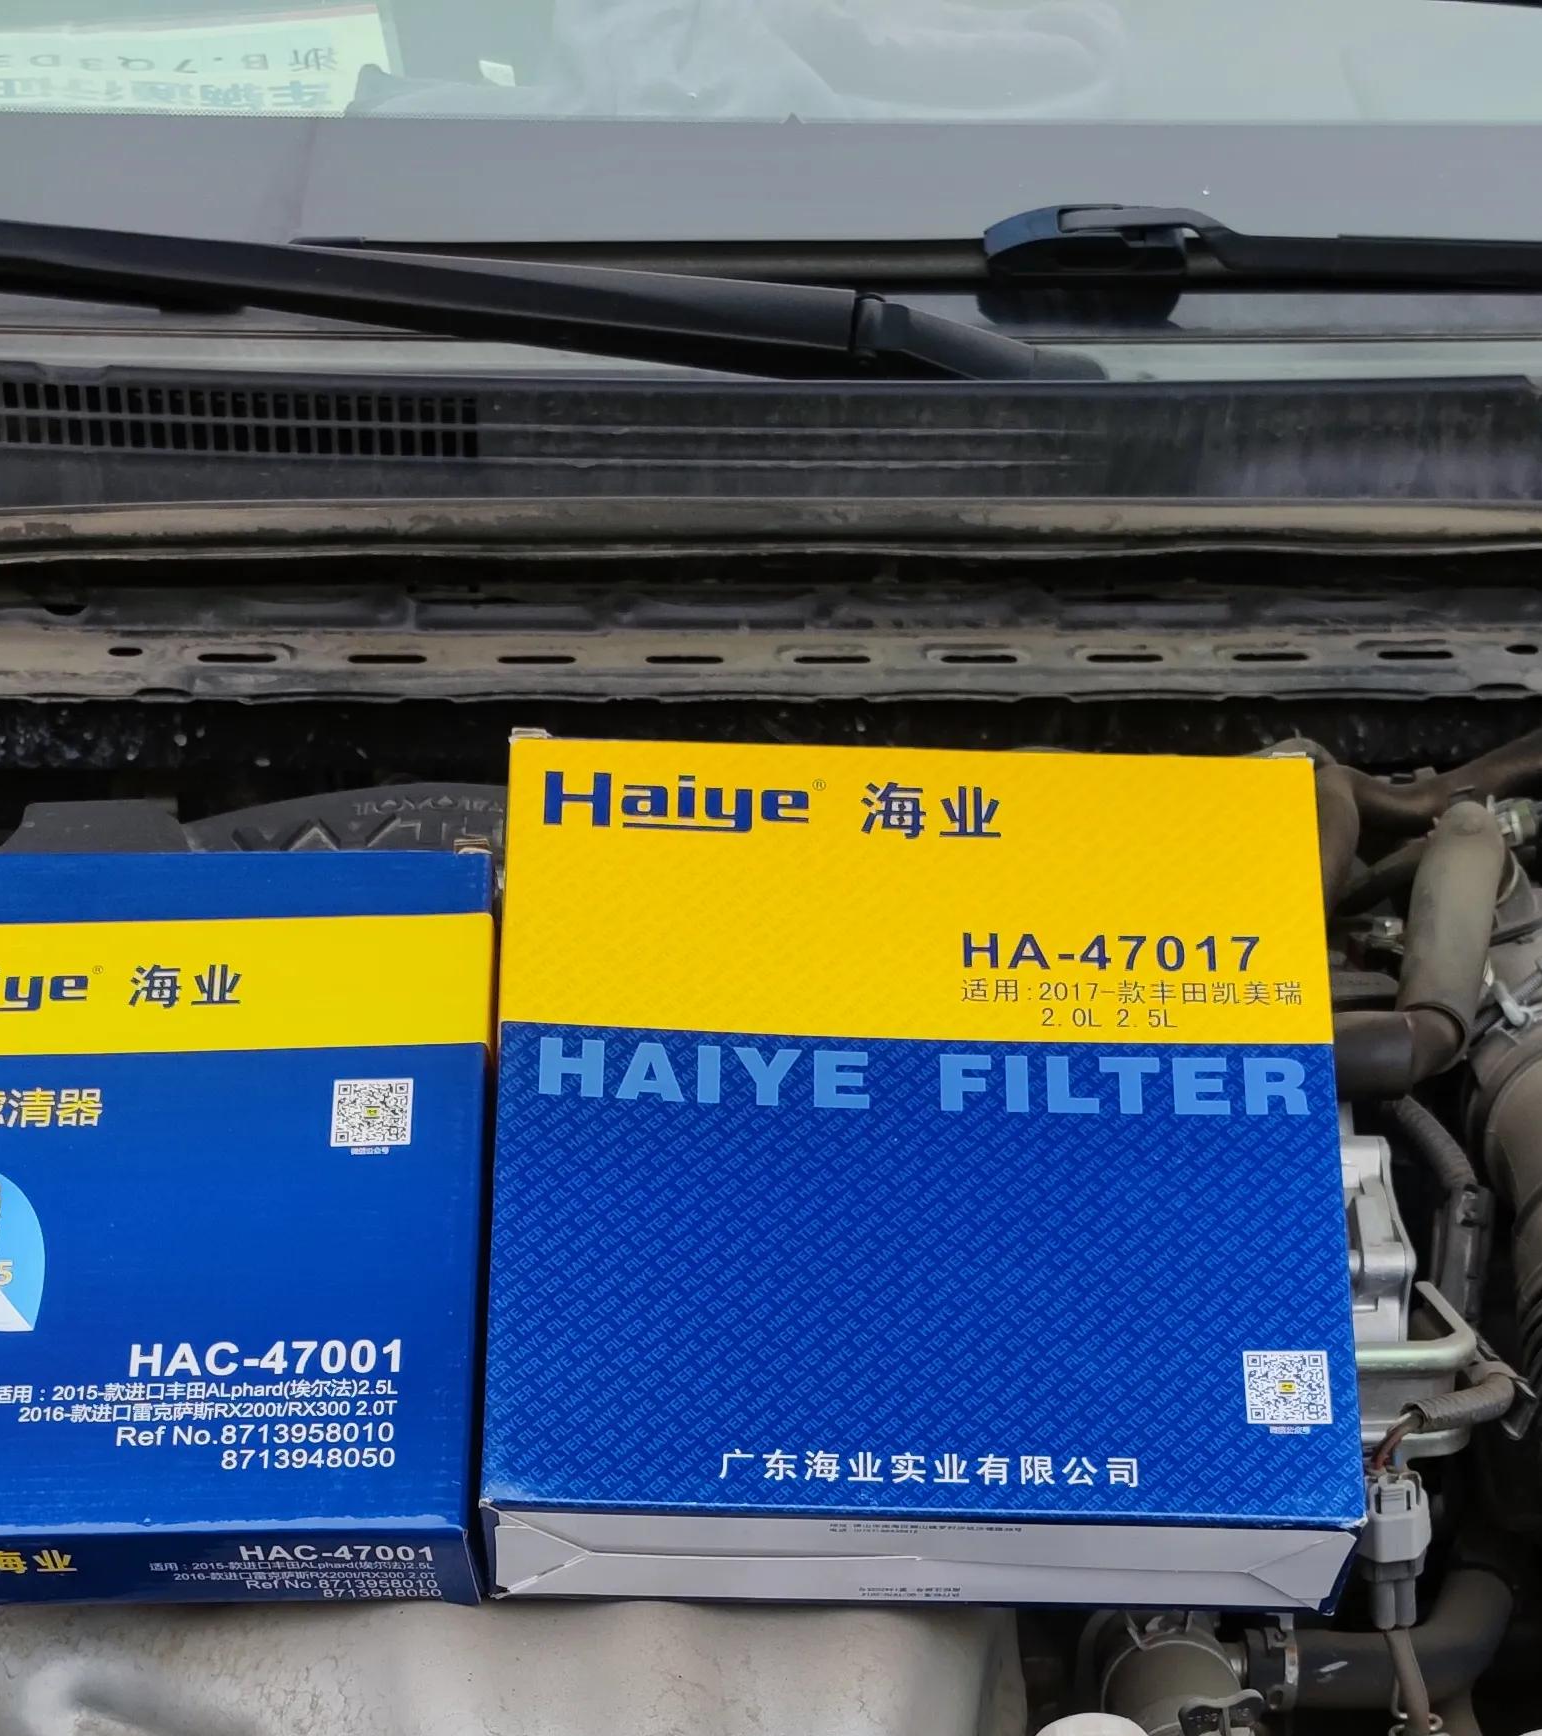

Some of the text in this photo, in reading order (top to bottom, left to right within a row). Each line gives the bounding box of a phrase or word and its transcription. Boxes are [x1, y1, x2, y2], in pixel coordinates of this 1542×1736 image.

[542, 770, 1003, 840] Haiye 海业
[961, 932, 1262, 973] HA-47017
[129, 963, 243, 1009] 海业
[537, 1036, 1310, 1117] HAIYE FILTER
[128, 1339, 402, 1378] HAC-47001
[116, 1426, 166, 1448] Ref
[221, 1447, 395, 1471] 8713948050
[719, 1449, 1143, 1488] 广东海业实业有限公司
[239, 1545, 433, 1561] HAC-47001
